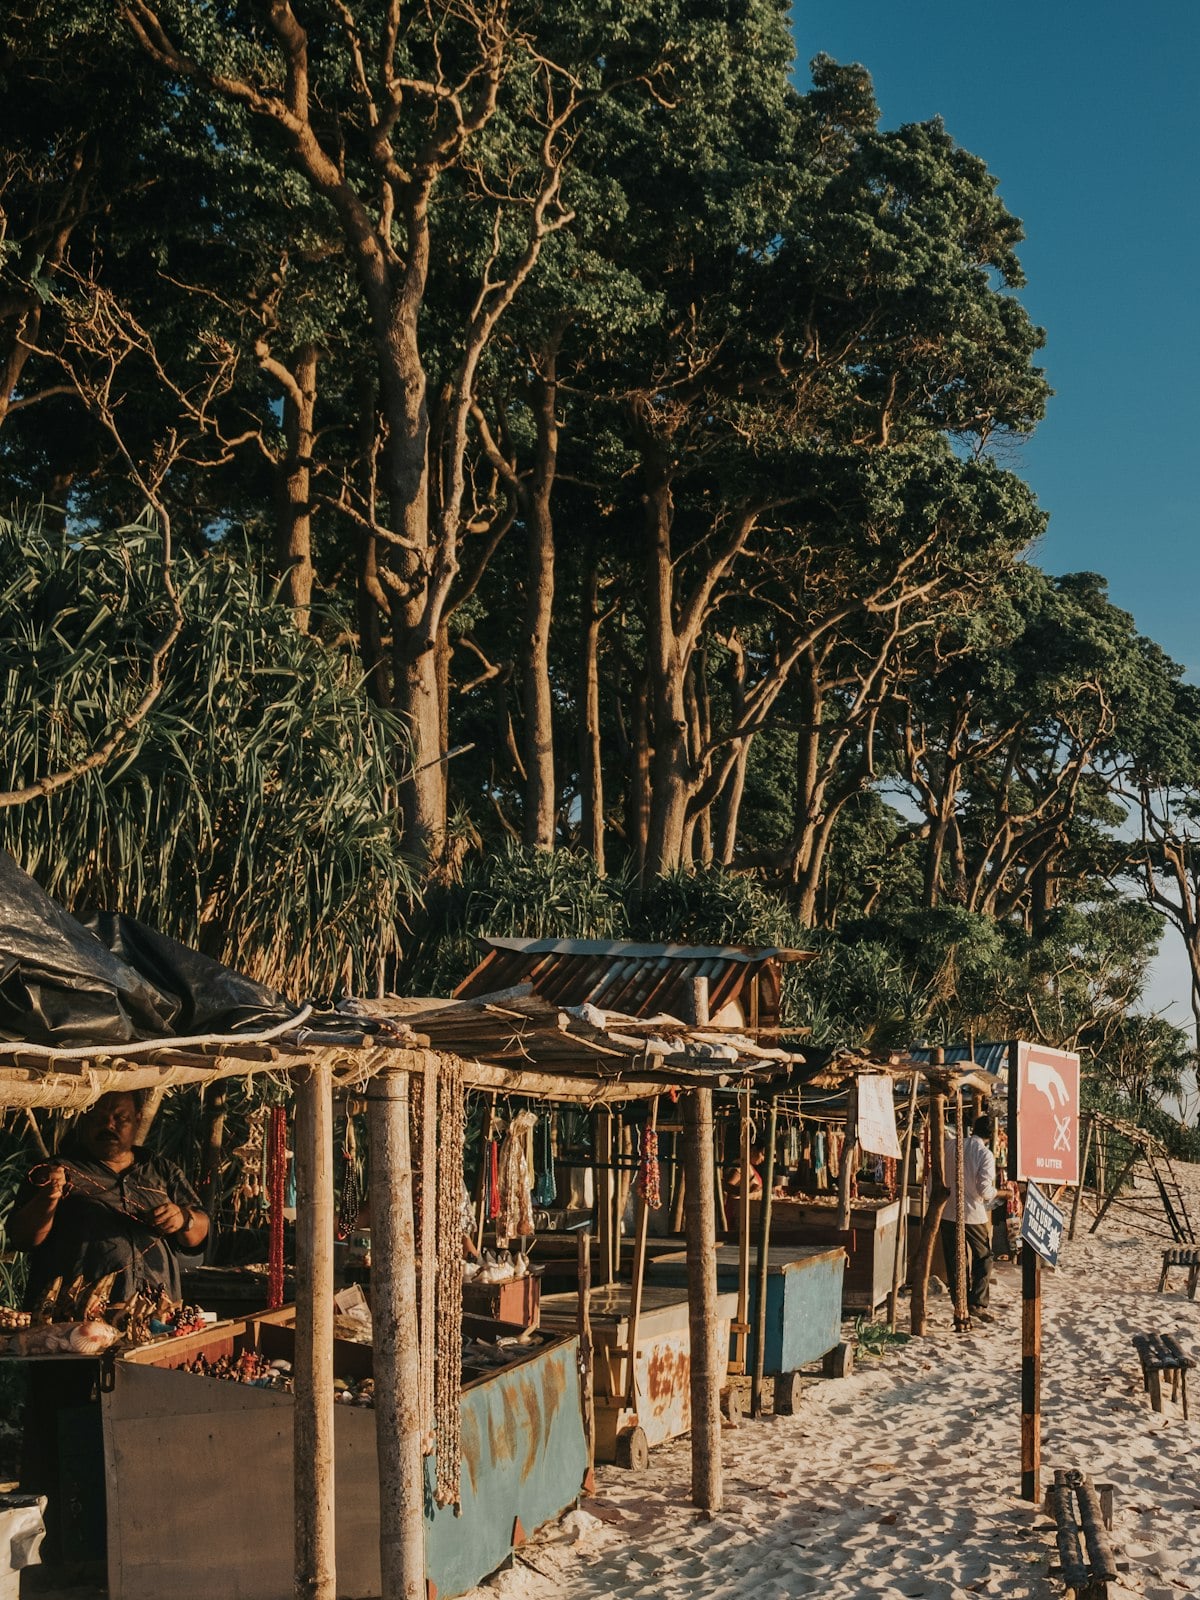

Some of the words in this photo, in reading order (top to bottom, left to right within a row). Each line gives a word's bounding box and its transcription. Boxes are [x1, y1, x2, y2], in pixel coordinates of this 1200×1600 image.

[1036, 1157, 1044, 1168] NO
[1045, 1158, 1062, 1169] LITTER
[1027, 1194, 1037, 1215] PAY
[1036, 1207, 1040, 1221] &
[1040, 1210, 1053, 1232] USE
[1028, 1214, 1046, 1240] TOILET
